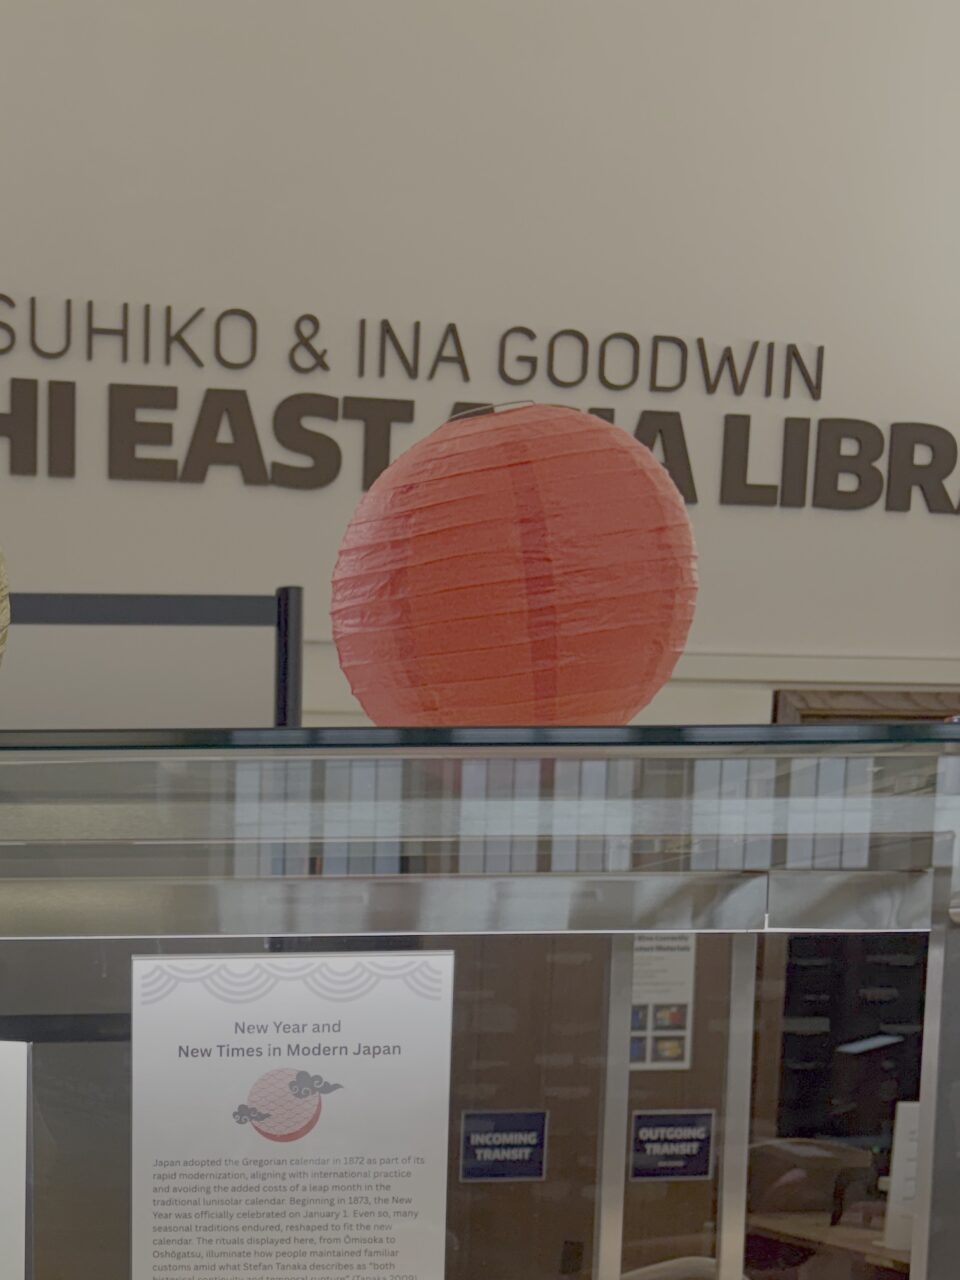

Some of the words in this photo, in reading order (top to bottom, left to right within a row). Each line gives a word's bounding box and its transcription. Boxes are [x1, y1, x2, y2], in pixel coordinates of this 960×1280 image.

[289, 313, 330, 374] &
[357, 318, 470, 383] INA
[497, 325, 825, 401] GOODWIN
[107, 382, 415, 490] EAST
[720, 413, 960, 515] LIBR
[234, 1021, 268, 1034] New
[273, 1020, 306, 1034] Year
[312, 1019, 342, 1033] and
[178, 1044, 212, 1057] New
[218, 1043, 263, 1057] Times
[267, 1043, 282, 1057] in
[286, 1042, 348, 1056] Modern
[353, 1042, 402, 1060] Japan
[470, 1132, 538, 1146] INCOMING
[639, 1126, 707, 1141] OUTGOING
[475, 1147, 531, 1161] TRANSIT
[645, 1141, 700, 1156] TRANSIT
[153, 1158, 181, 1169] Japan
[183, 1157, 222, 1169] adopted
[224, 1157, 240, 1166] the
[241, 1157, 288, 1169] Gregorian
[289, 1156, 330, 1166] calendar
[332, 1156, 341, 1165] in
[344, 1157, 365, 1165] 1872
[379, 1157, 399, 1167] part
[401, 1156, 411, 1165] of
[413, 1156, 425, 1165] its
[152, 1171, 177, 1182] rapid
[250, 1170, 287, 1181] aligning
[288, 1170, 309, 1179] with
[311, 1169, 371, 1178] international
[373, 1169, 412, 1180] practice
[152, 1184, 170, 1193] and
[172, 1184, 211, 1195] avoiding
[213, 1184, 229, 1193] the
[230, 1184, 261, 1193] added
[262, 1184, 288, 1193] costs
[289, 1183, 300, 1192] of
[309, 1183, 329, 1195] leap
[331, 1183, 362, 1192] month
[364, 1183, 373, 1192] in
[375, 1183, 391, 1192] the
[152, 1197, 201, 1206] traditional
[202, 1197, 242, 1206] lunisolar
[289, 1196, 335, 1208] Beginning
[337, 1196, 346, 1205] in
[373, 1196, 390, 1205] the
[391, 1196, 413, 1205] New
[152, 1211, 172, 1219] Year
[194, 1210, 234, 1221] officially
[236, 1210, 287, 1219] celebrated
[303, 1210, 341, 1221] January
[352, 1210, 376, 1218] Even
[393, 1211, 419, 1220] many
[152, 1223, 193, 1232] seasonal
[194, 1223, 240, 1232] traditions
[285, 1222, 329, 1234] reshaped
[331, 1223, 341, 1231] to
[343, 1222, 353, 1231] fit
[355, 1222, 371, 1231] the
[197, 1236, 214, 1245] The
[215, 1236, 245, 1245] rituals
[246, 1236, 292, 1247] displayed
[319, 1236, 342, 1244] from
[385, 1236, 396, 1244] to
